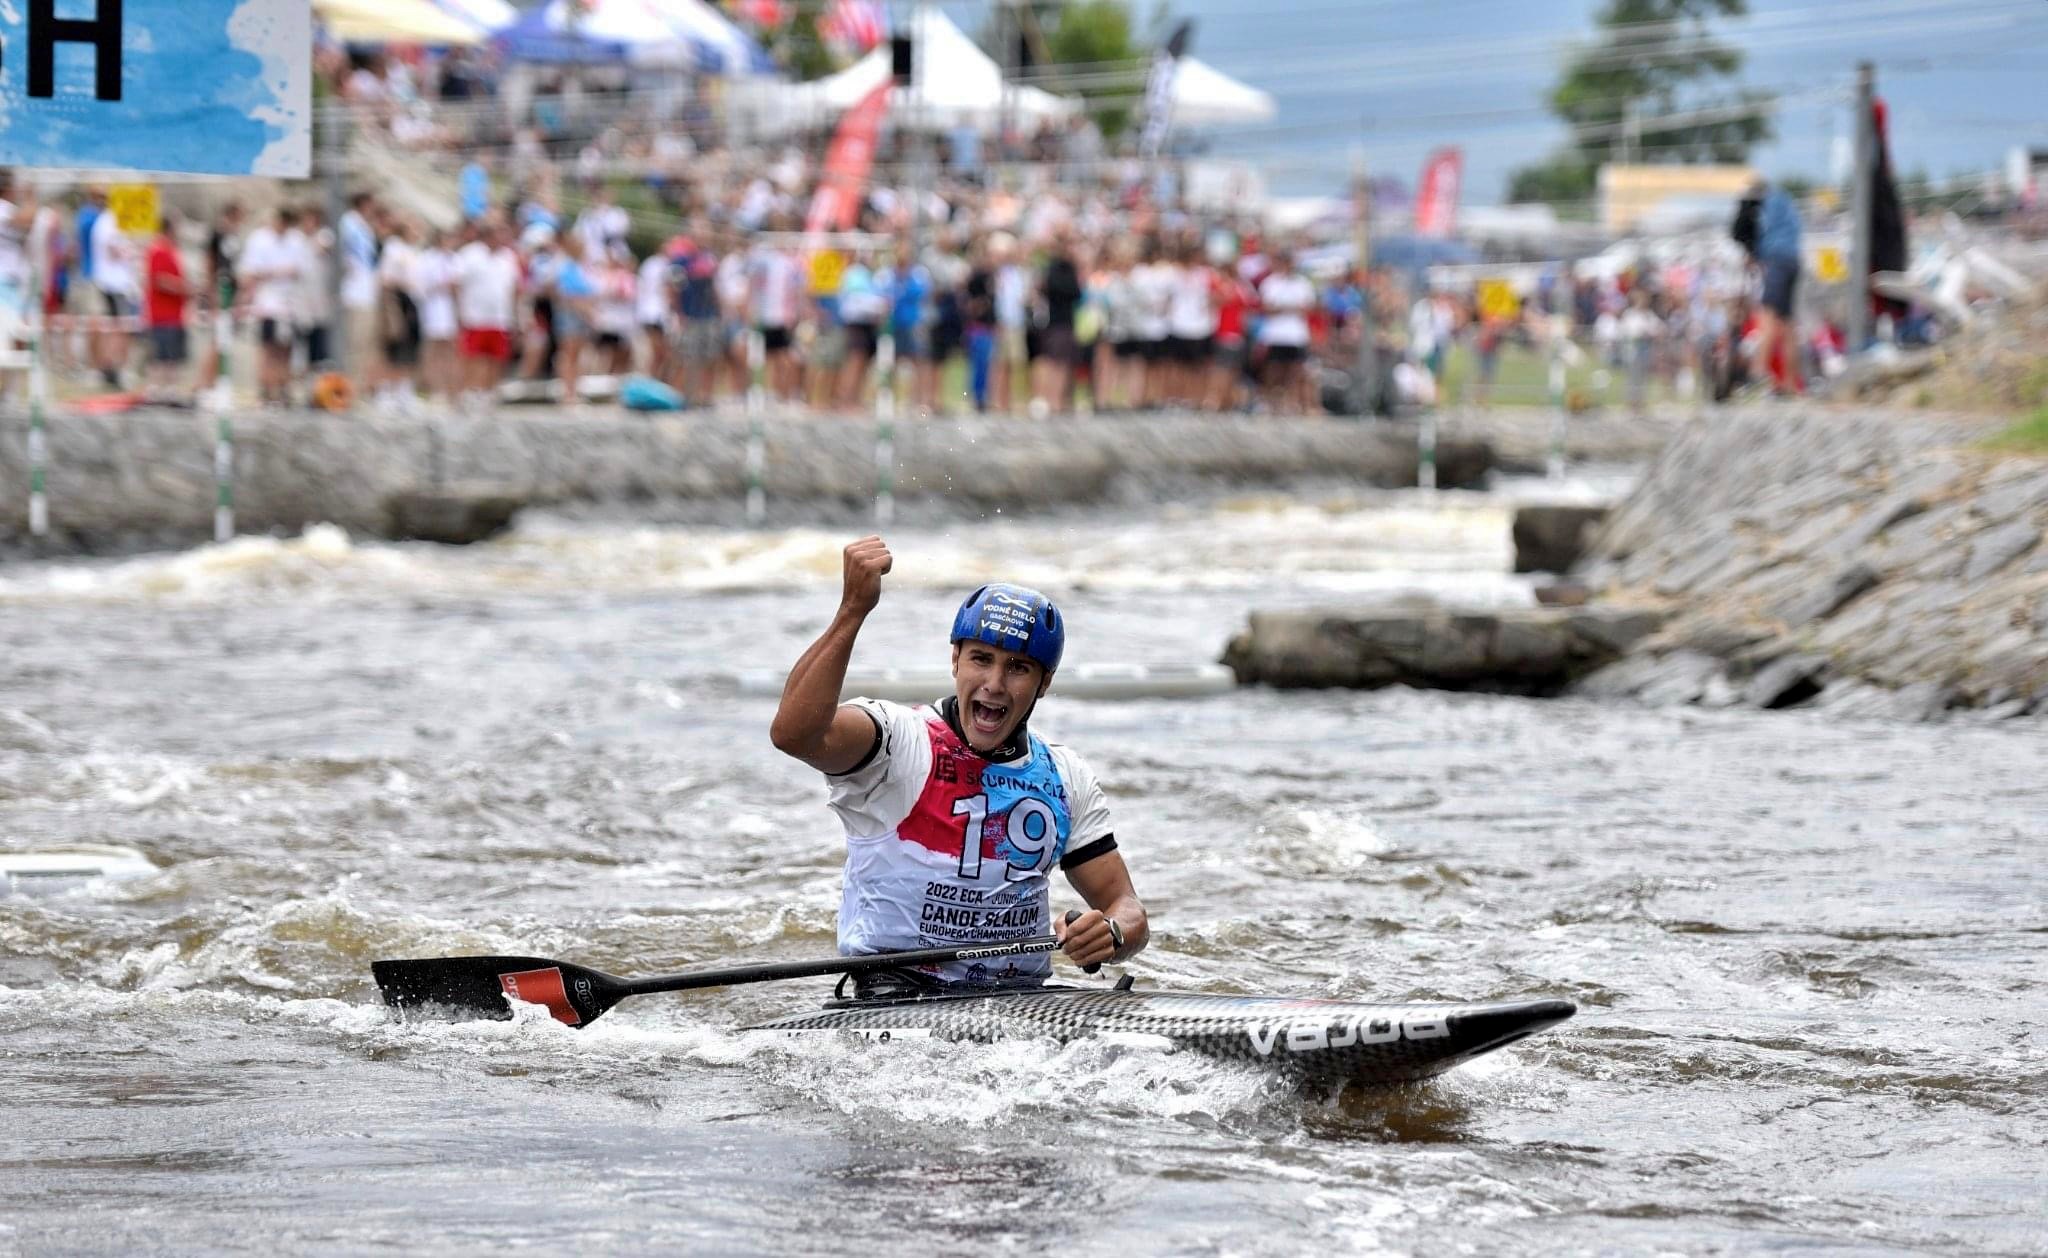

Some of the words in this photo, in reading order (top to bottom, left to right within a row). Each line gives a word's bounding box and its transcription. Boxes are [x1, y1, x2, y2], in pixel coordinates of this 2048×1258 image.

[1011, 609, 1036, 624] DIELO
[966, 771, 1040, 793] SKUPINA
[951, 792, 1058, 883] 19
[926, 881, 958, 901] 2022
[959, 888, 983, 905] ECA
[921, 902, 981, 929] CANOE
[982, 905, 1040, 929] SLALOM
[919, 921, 970, 940] EUROPEAN
[970, 924, 1037, 941] CHAMPIONSHIPS
